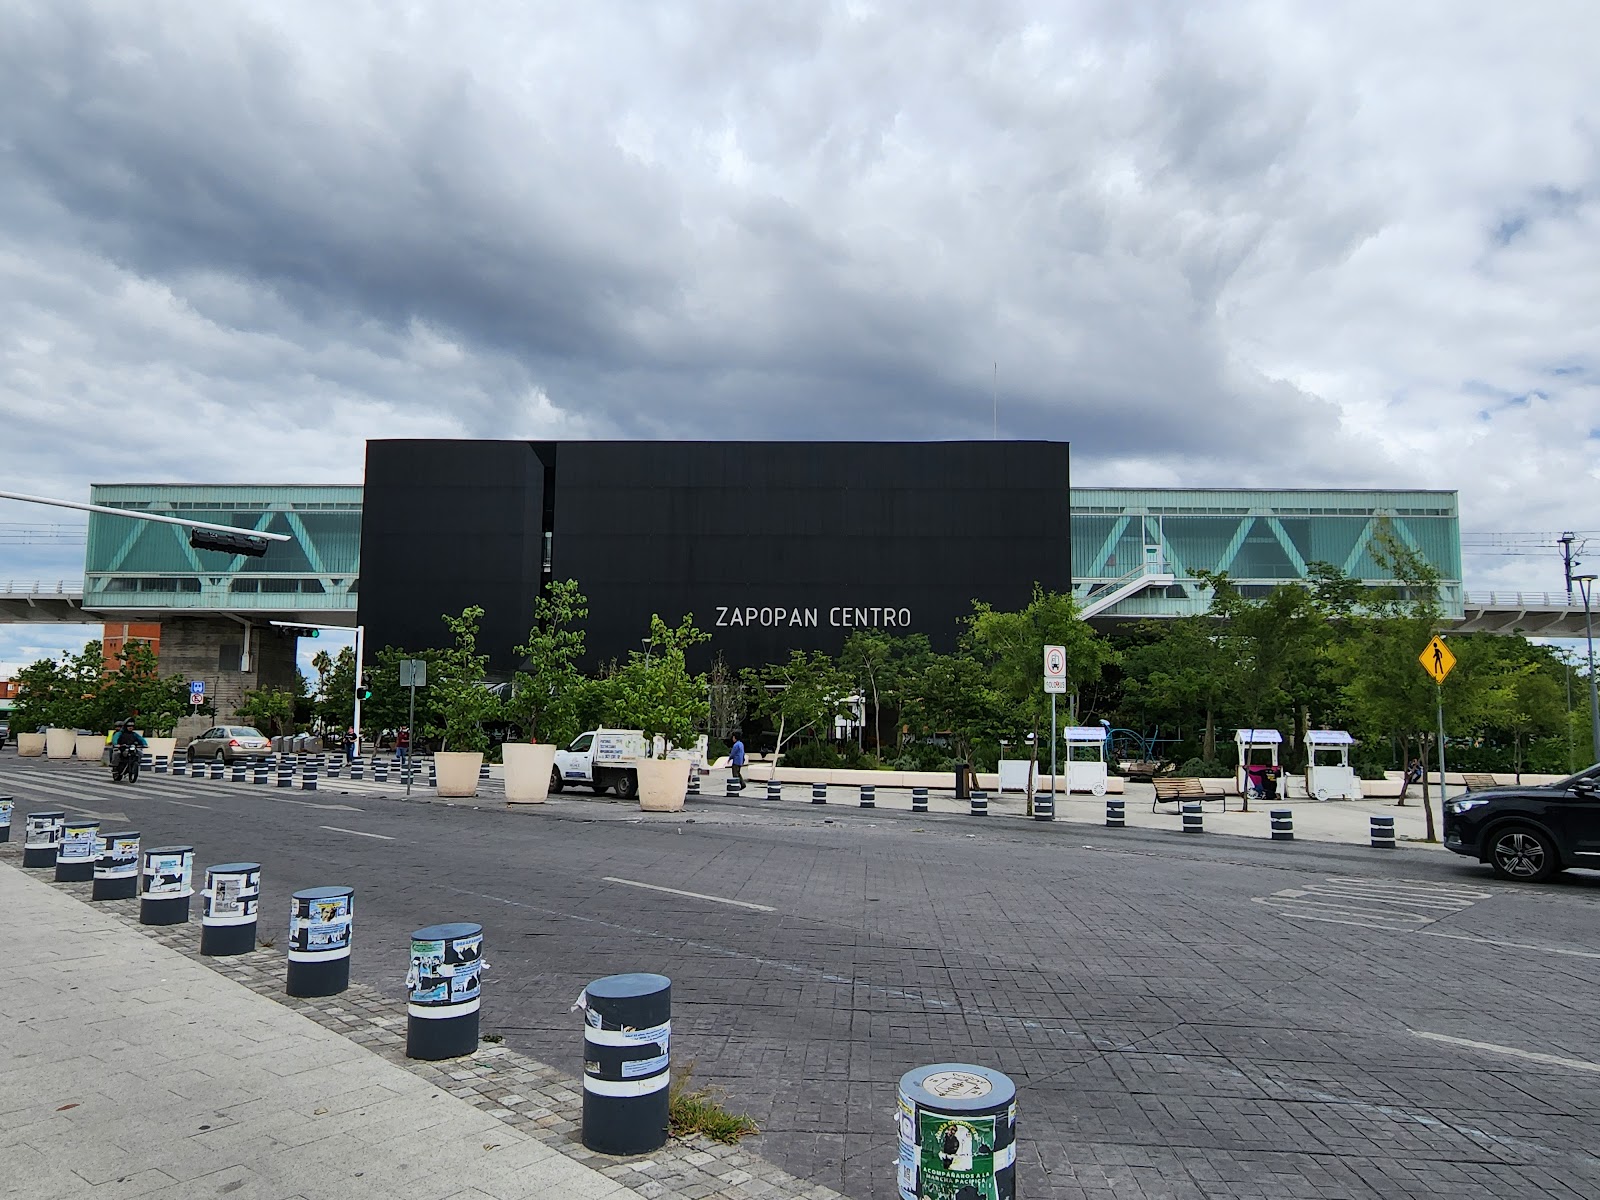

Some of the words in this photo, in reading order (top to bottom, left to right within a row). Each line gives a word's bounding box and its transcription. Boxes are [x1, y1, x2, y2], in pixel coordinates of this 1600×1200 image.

[715, 606, 819, 628] ZAPOPAN
[829, 606, 911, 628] CENTRO
[925, 1173, 953, 1184] MARCHA
